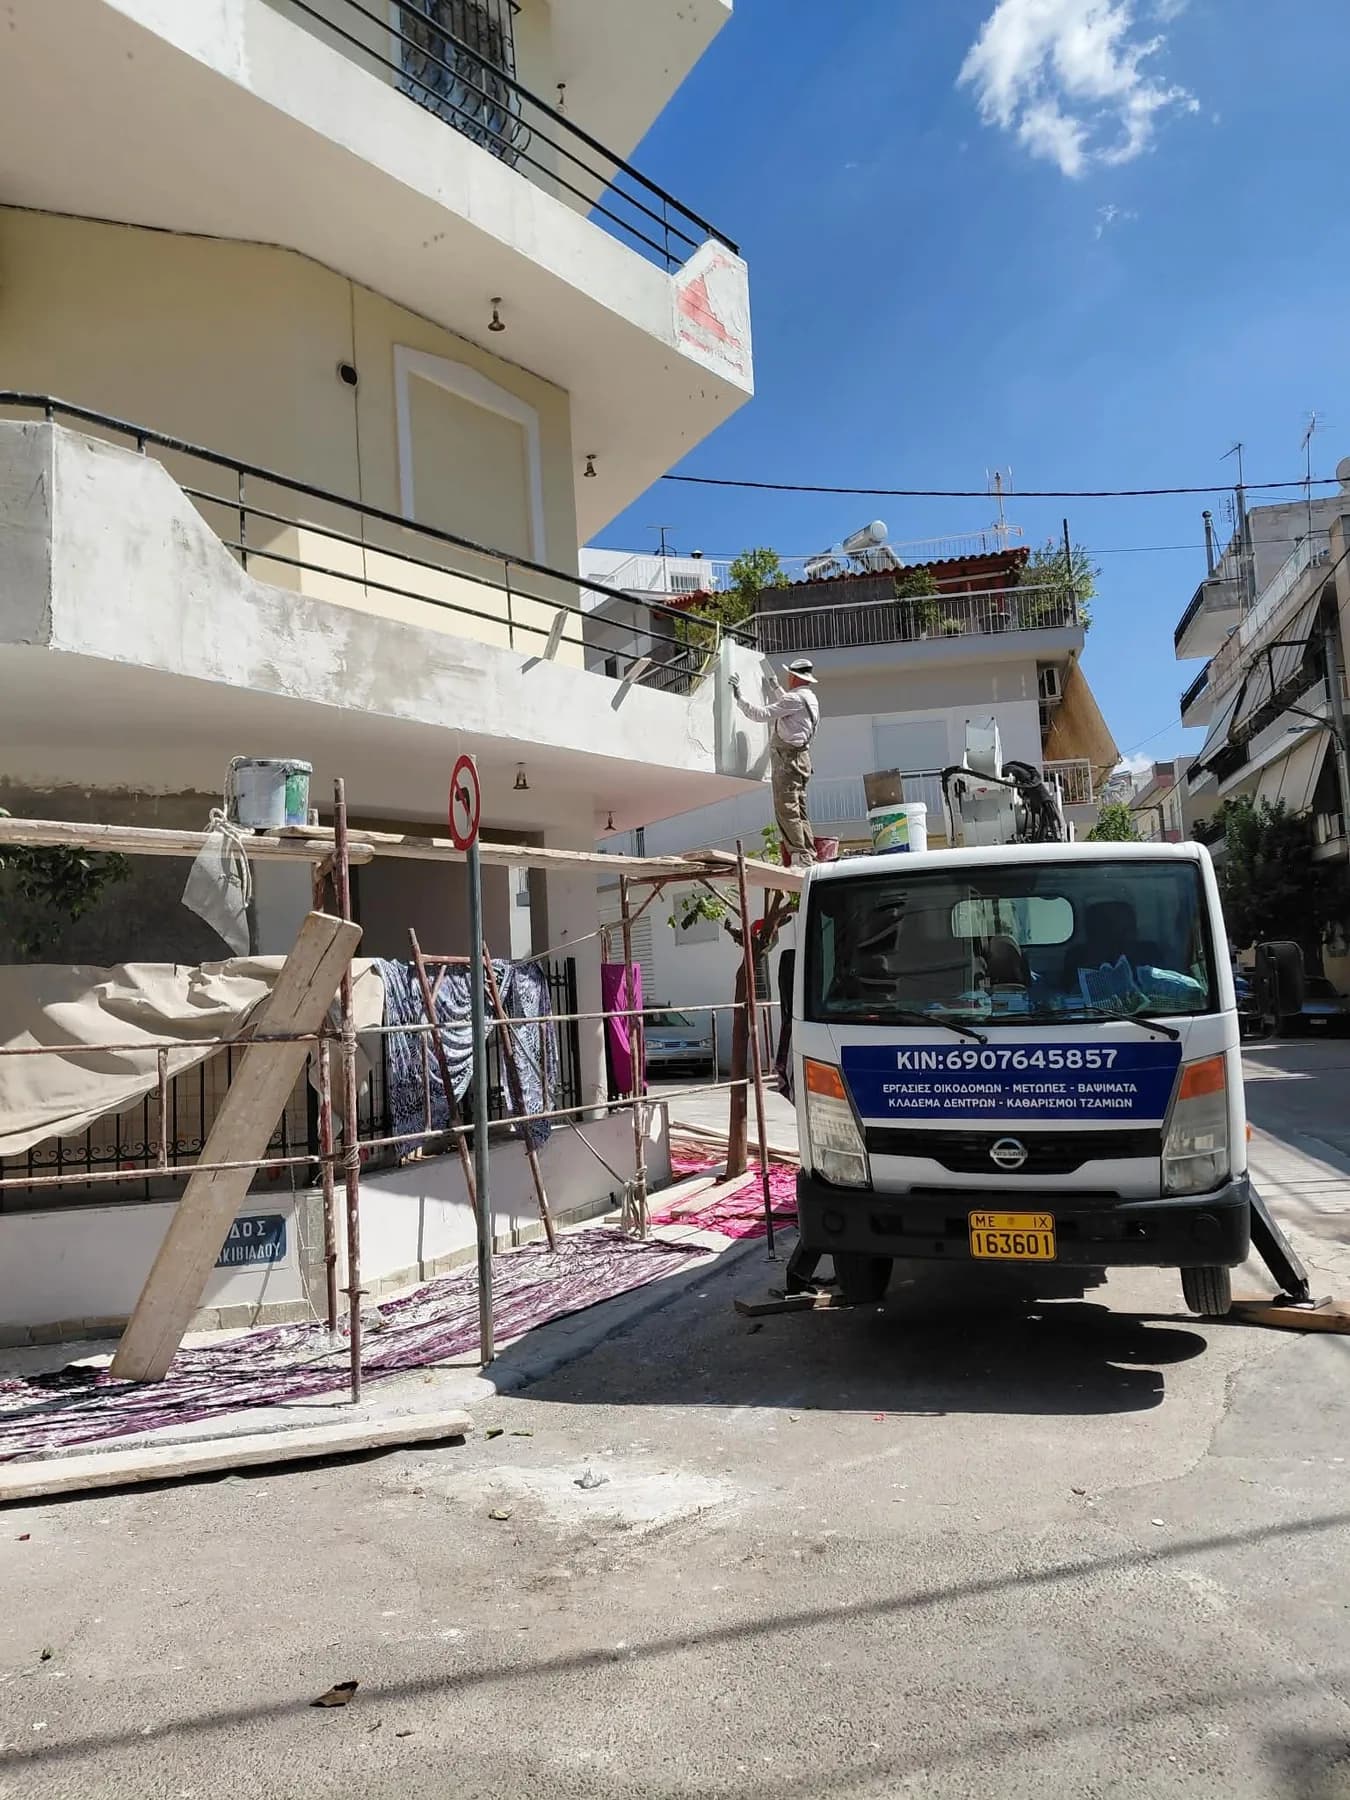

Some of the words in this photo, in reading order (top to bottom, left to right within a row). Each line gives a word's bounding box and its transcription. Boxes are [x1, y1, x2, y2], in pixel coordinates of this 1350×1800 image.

[896, 1049, 1118, 1070] ΚΙΝ:6907645857
[882, 1083, 932, 1093] ΕΡΓΑΣΙΕΣ
[933, 1083, 1002, 1093] ΟΙΚΟΔΟΜΩΝ
[1012, 1083, 1067, 1093] ΜΕΤΩΠΕΣ
[1077, 1083, 1138, 1093] ΒΑΨΙΜΑΤΑ
[888, 1098, 941, 1108] ΚΛΑΔΕΜΑ
[943, 1098, 996, 1108] ΔΕΝΤΡΩΝ
[1006, 1098, 1077, 1108] ΚΑΘΑΡΙΣΜΟΙ
[1079, 1098, 1133, 1108] ΤΖΑΜΙΩΝ
[229, 1221, 266, 1239] ΔΟΣ
[975, 1215, 996, 1228] ΜΕ
[1033, 1216, 1049, 1229] ΙΧ
[219, 1242, 281, 1263] ΚΙΒΙΑΔΟΥ
[976, 1233, 1050, 1256] 163601
